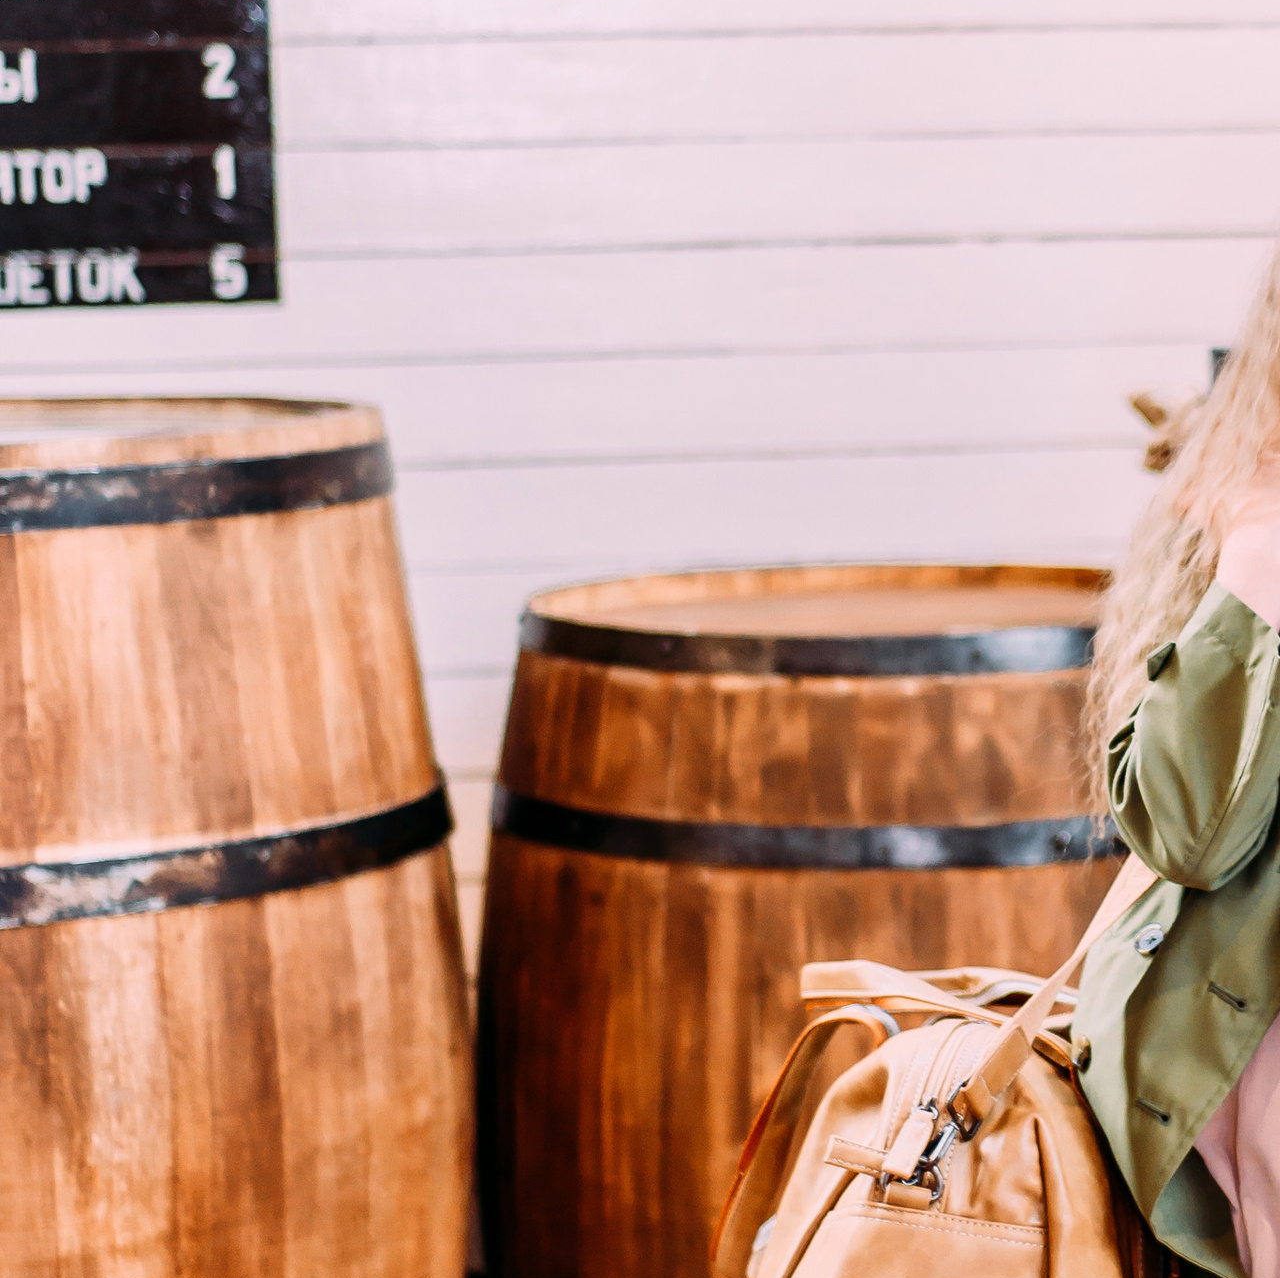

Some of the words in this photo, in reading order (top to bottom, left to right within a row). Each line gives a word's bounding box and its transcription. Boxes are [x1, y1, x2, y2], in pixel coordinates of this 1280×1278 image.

[203, 42, 237, 99] 2
[212, 144, 237, 201] 1
[210, 241, 248, 301] 5
